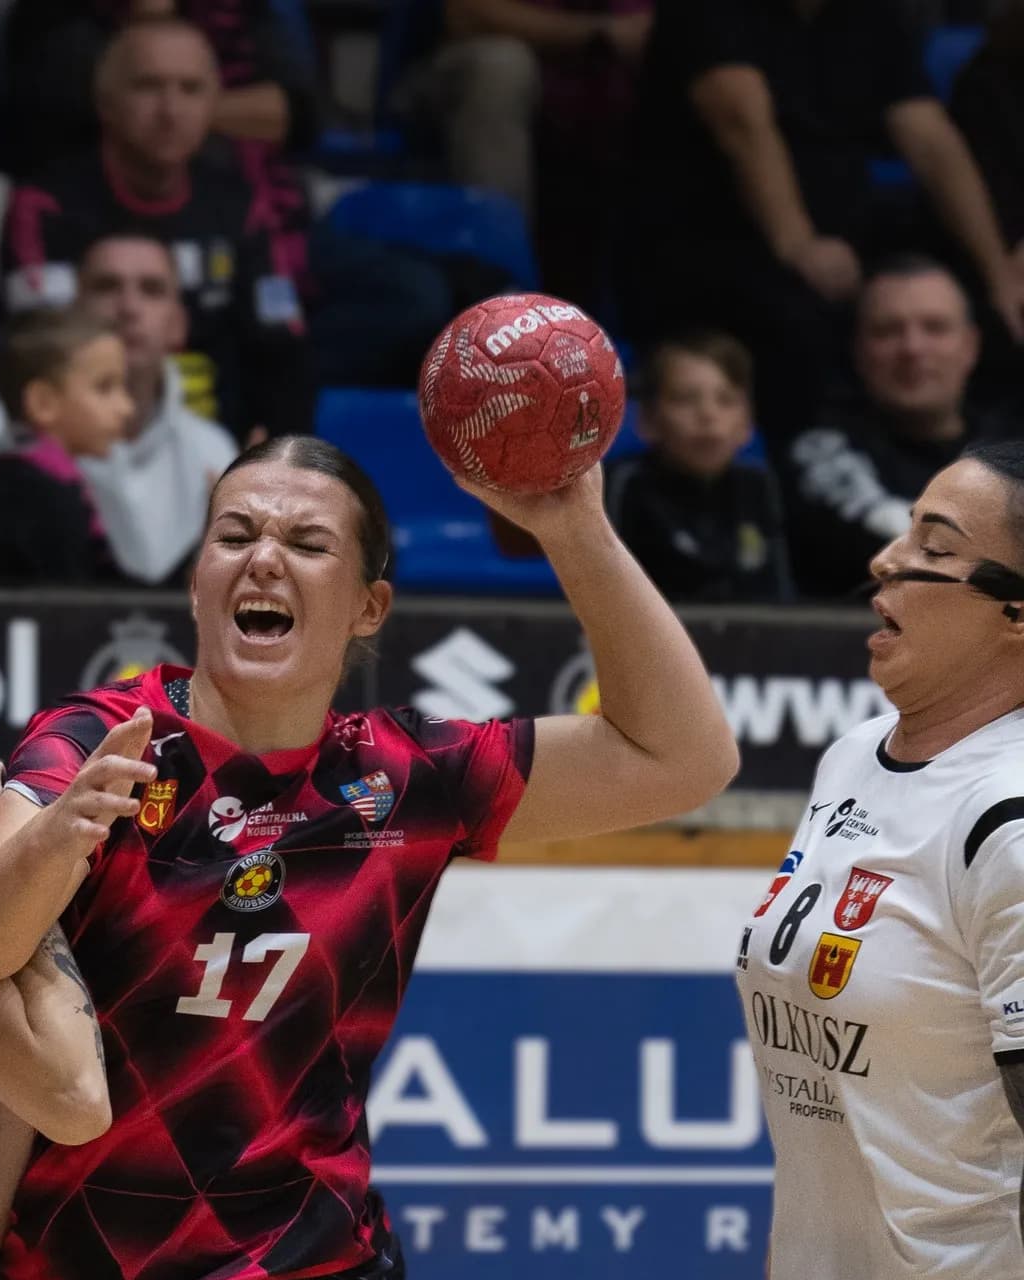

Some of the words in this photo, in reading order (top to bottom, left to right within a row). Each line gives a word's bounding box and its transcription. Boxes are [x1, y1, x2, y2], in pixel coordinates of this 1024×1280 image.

[486, 304, 588, 356] molten
[246, 825, 284, 838] KOBIET
[247, 811, 309, 825] CENTRALNA
[239, 854, 277, 870] KORONA
[769, 883, 822, 966] 8
[176, 932, 310, 1021] 17
[752, 991, 871, 1077] OLKUSZ
[789, 1101, 845, 1124] PROPERTY
